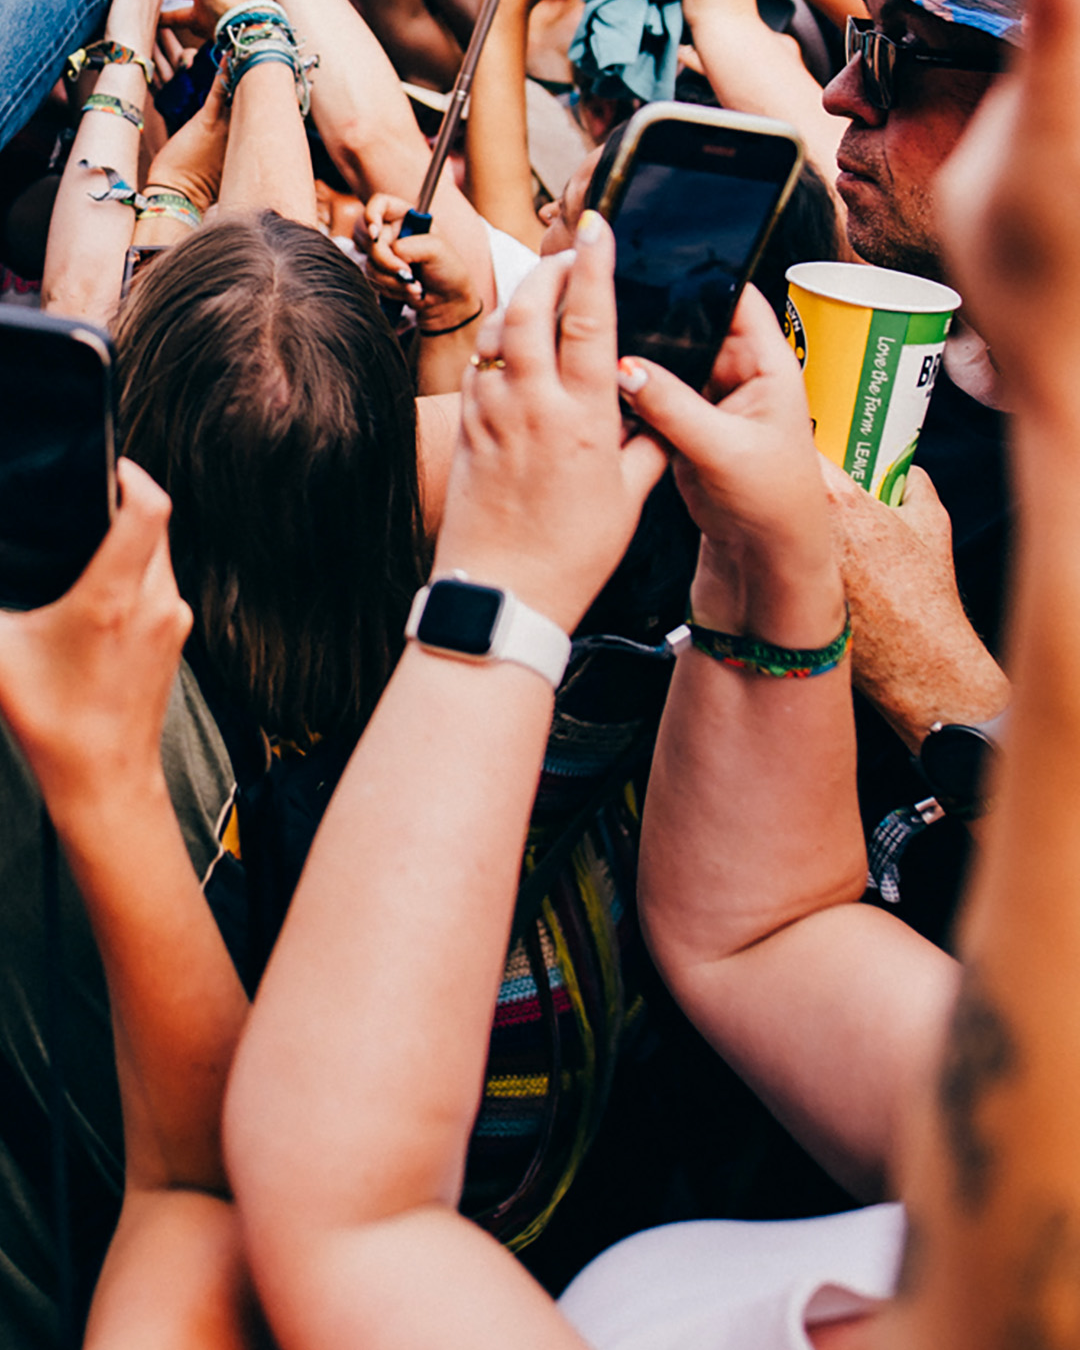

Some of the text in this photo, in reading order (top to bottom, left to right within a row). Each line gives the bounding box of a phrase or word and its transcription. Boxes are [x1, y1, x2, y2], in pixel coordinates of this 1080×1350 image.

[850, 336, 896, 480] Love the Farm LEAVE
